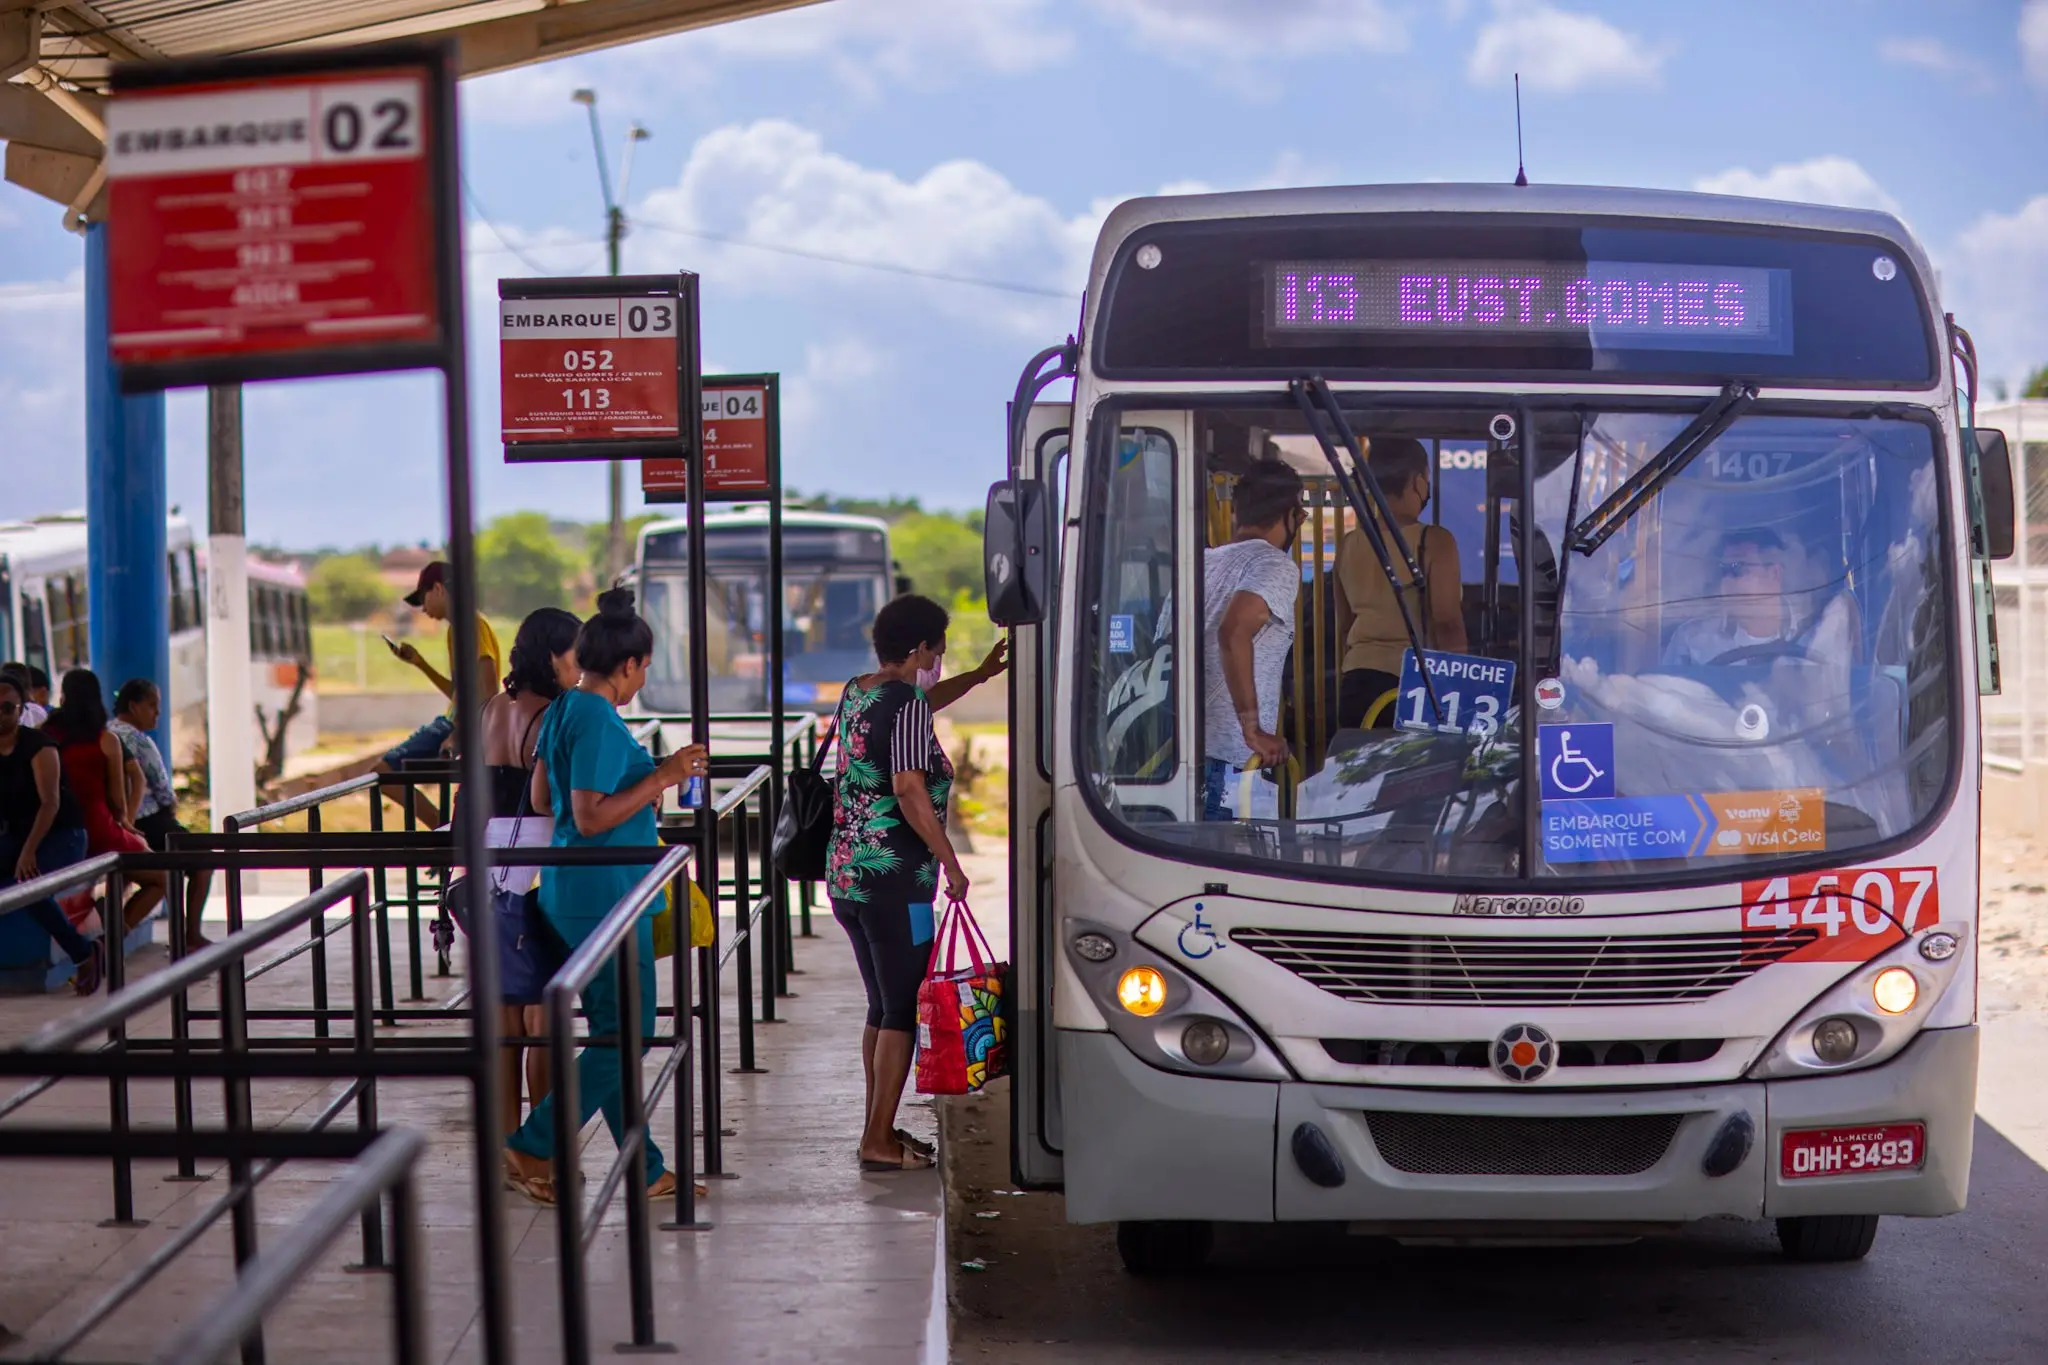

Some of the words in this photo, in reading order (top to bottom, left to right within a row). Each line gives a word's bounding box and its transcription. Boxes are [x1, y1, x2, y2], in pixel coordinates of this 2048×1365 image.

[323, 98, 412, 152] 02
[115, 118, 308, 156] EMBARQUE
[503, 314, 616, 327] EMBARQUE
[628, 306, 672, 332] 03
[563, 350, 614, 370] 052
[562, 388, 610, 409] 113
[726, 396, 758, 415] 04
[1402, 686, 1500, 736] 113
[1549, 812, 1653, 831] EMBARQUE
[1549, 832, 1638, 850] SOMENTE
[1643, 829, 1686, 845] COM
[1744, 830, 1780, 846] VISA
[1453, 893, 1585, 916] Marcopolo
[1747, 870, 1935, 940] 4407
